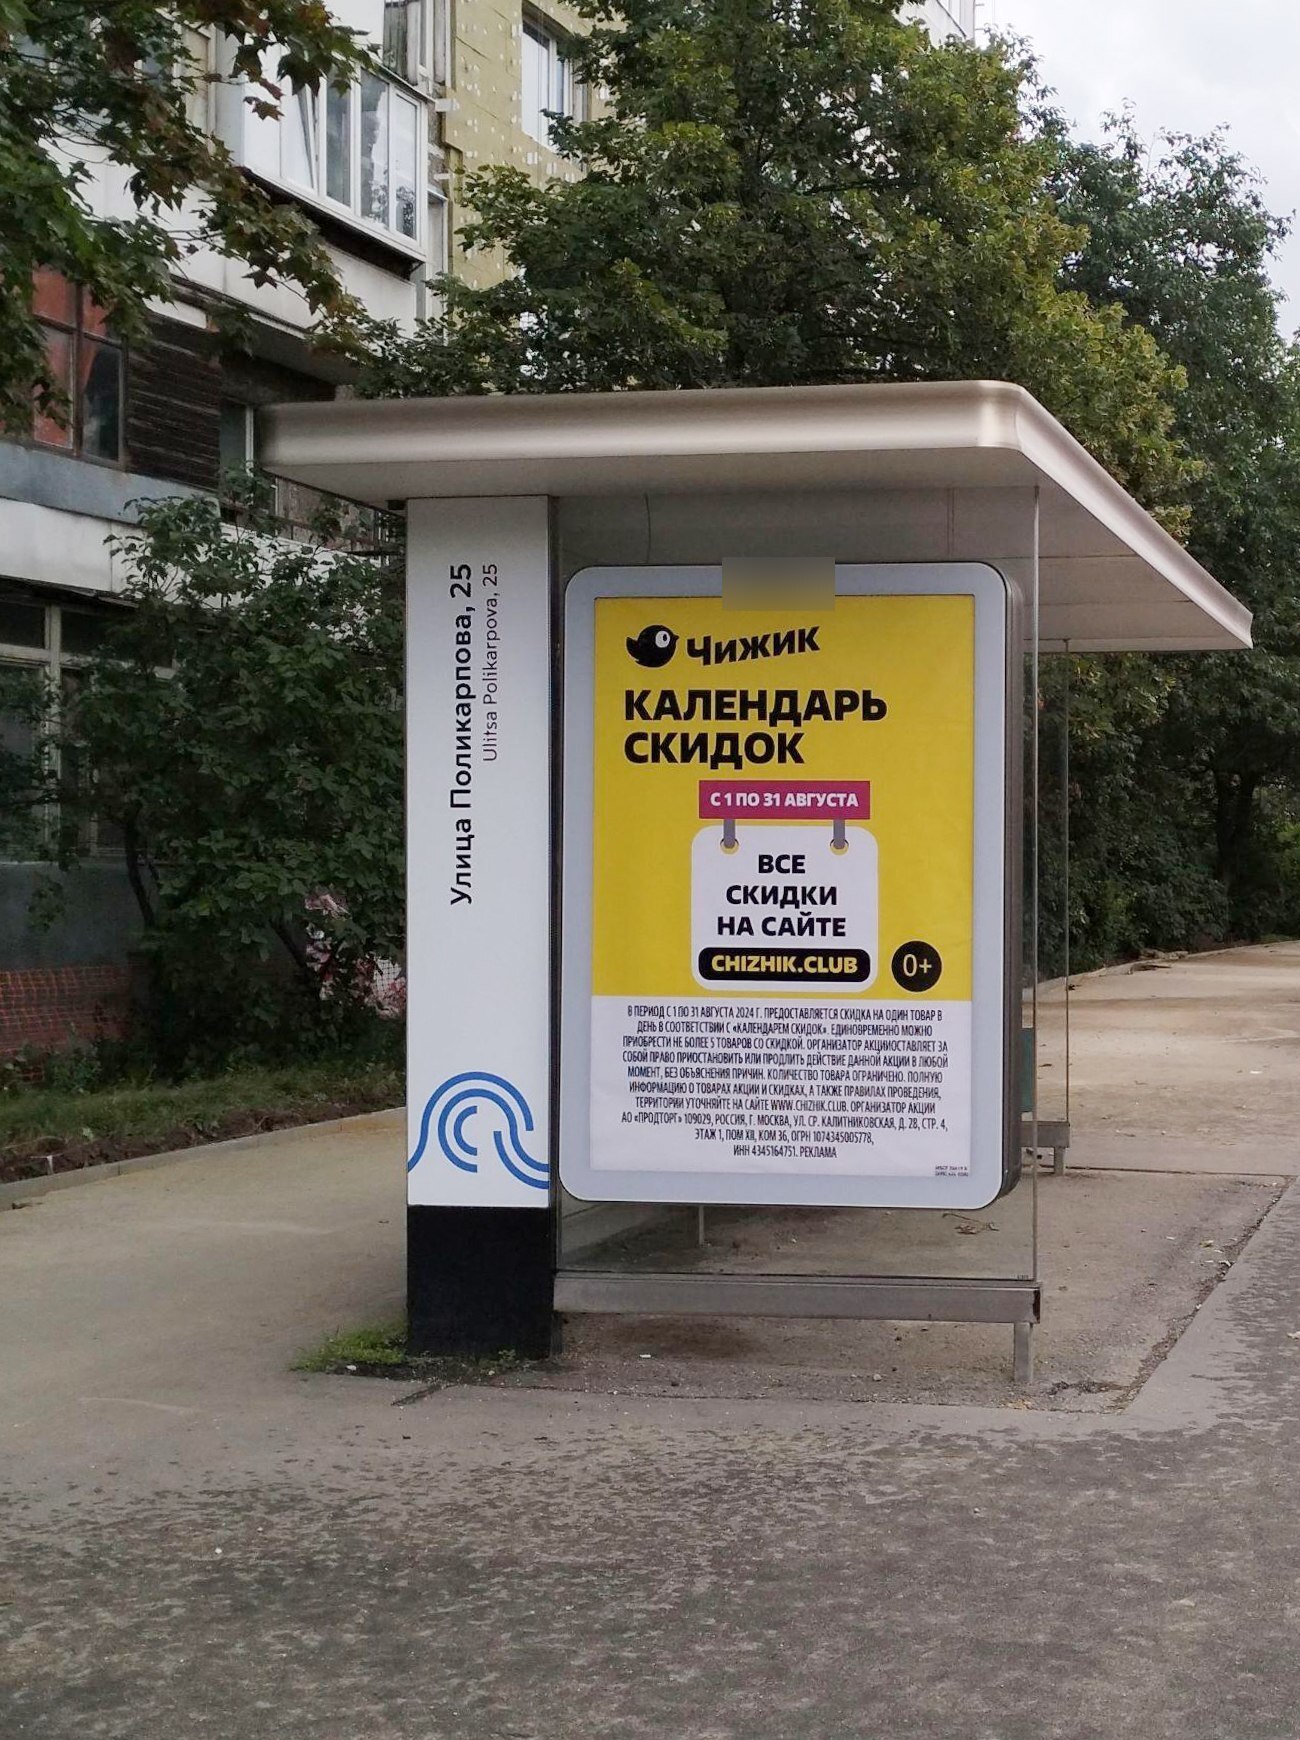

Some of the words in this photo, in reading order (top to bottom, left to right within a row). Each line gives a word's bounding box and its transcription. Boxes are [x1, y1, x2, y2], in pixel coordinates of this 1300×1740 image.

[450, 564, 472, 597] 25
[483, 564, 497, 585] 25
[483, 593, 501, 704] Polikarpova,
[687, 627, 820, 666] Чижик
[450, 606, 476, 809] Поликарпова,
[625, 690, 887, 727] КАЛЕНДАРЬ
[483, 712, 497, 761] Ulitsa
[624, 732, 805, 769] СКИДОК
[711, 792, 721, 807] С
[724, 792, 732, 807] 1
[737, 792, 759, 807] ПО
[764, 792, 781, 807] 31
[784, 792, 858, 808] АВГУСТА
[450, 819, 474, 905] Улица
[758, 854, 805, 874] ВСЕ
[726, 886, 837, 909] СКИДКИ
[718, 917, 754, 936] НА
[762, 911, 846, 937] САЙТЕ
[712, 955, 858, 973] CHIZHIK.CLUB
[903, 954, 932, 976] 0+
[628, 1005, 632, 1017] В
[634, 1005, 664, 1019] ПЕРИОД
[666, 1006, 671, 1017] С
[673, 1006, 677, 1017] 1
[678, 1006, 689, 1017] ПО
[691, 1006, 699, 1017] 31
[700, 1006, 734, 1018] АВГУСТА
[736, 1007, 754, 1018] 2024
[764, 1007, 838, 1021] ПРЕДОСТАВЛЯЕТСЯ
[840, 1008, 871, 1021] СКИДКА
[872, 1008, 883, 1019] НА
[885, 1008, 908, 1021] ОДИН
[910, 1009, 934, 1020] ТОВАР
[937, 1009, 942, 1020] В
[637, 1021, 657, 1035] ДЕНЬ
[659, 1021, 663, 1032] В
[665, 1022, 723, 1033] СООТВЕТСТВИИ
[725, 1022, 730, 1033] С
[732, 1022, 789, 1036] «КАЛЕНДАРЕМ
[831, 1023, 899, 1037] ЕДИНОВРЕМЕННО
[901, 1024, 932, 1035] МОЖНО
[623, 1036, 671, 1047] ПРИОБРЕСТИ
[673, 1037, 682, 1047] НЕ
[684, 1037, 708, 1048] БОЛЕЕ
[710, 1037, 714, 1048] 5
[717, 1037, 751, 1048] ТОВАРОВ
[753, 1038, 763, 1048] СО
[765, 1036, 804, 1051] СКИДКОЙ.
[807, 1038, 862, 1049] ОРГАНИЗАТОР
[937, 1040, 948, 1051] ЗА
[622, 1049, 648, 1062] СОБОЙ
[650, 1052, 676, 1062] ПРАВО
[677, 1052, 742, 1063] ПРИОСТАНОВИТЬ
[745, 1053, 761, 1063] ИЛИ
[762, 1053, 804, 1066] ПРОДЛИТЬ
[806, 1052, 846, 1067] ДЕЙСТВИЕ
[848, 1052, 881, 1067] ДАННОЙ
[882, 1055, 909, 1068] АКЦИИ
[912, 1055, 916, 1065] В
[918, 1053, 948, 1066] ЛЮБОЙ
[628, 1067, 662, 1079] МОМЕНТ,
[665, 1067, 678, 1077] БЕЗ
[680, 1067, 730, 1078] ОБЪЯСНЕНИЯ
[732, 1068, 764, 1079] ПРИЧИН.
[767, 1069, 817, 1080] КОЛИЧЕСТВО
[819, 1069, 850, 1080] ТОВАРА
[852, 1070, 905, 1081] ОГРАНИЧЕНО.
[908, 1070, 942, 1082] ПОЛНУЮ
[629, 1082, 687, 1095] ИНФОРМАЦИЮ
[689, 1083, 694, 1093] О
[696, 1083, 731, 1094] ТОВАРАХ
[732, 1083, 759, 1096] АКЦИИ
[761, 1084, 767, 1094] И
[768, 1084, 807, 1097] СКИДКАХ,
[809, 1084, 814, 1095] А
[816, 1085, 842, 1095] ТАКЖЕ
[844, 1085, 886, 1096] ПРАВИЛАХ
[887, 1086, 941, 1099] ПРОВЕДЕНИЯ,
[636, 1097, 683, 1108] ТЕРРИТОРИИ
[686, 1096, 731, 1109] УТОЧНЯЙТЕ
[733, 1099, 742, 1109] НА
[745, 1097, 769, 1109] САЙТЕ
[850, 1100, 906, 1111] ОРГАНИЗАТОР
[908, 1101, 935, 1114] АКЦИИ
[622, 1113, 632, 1123] АО
[634, 1113, 682, 1126] «ПРОДТОРГ»
[716, 1114, 747, 1127] РОССИЯ,
[758, 1115, 791, 1128] МОСКВА,
[808, 1116, 819, 1126] СР.
[821, 1116, 896, 1130] КАЛИТНИКОВСКАЯ,
[898, 1117, 906, 1130] Д.
[908, 1117, 920, 1130] 28,
[922, 1118, 938, 1129] СТР.
[940, 1118, 948, 1131] 4,
[695, 1128, 716, 1139] ЭТАЖ
[718, 1129, 723, 1141] 1,
[726, 1129, 742, 1139] ПОМ
[758, 1129, 776, 1140] КОМ
[778, 1130, 789, 1142] 36,
[791, 1130, 811, 1141] ОГРН
[734, 1145, 750, 1155] ИНН
[800, 1146, 837, 1157] РЕКЛАМА
